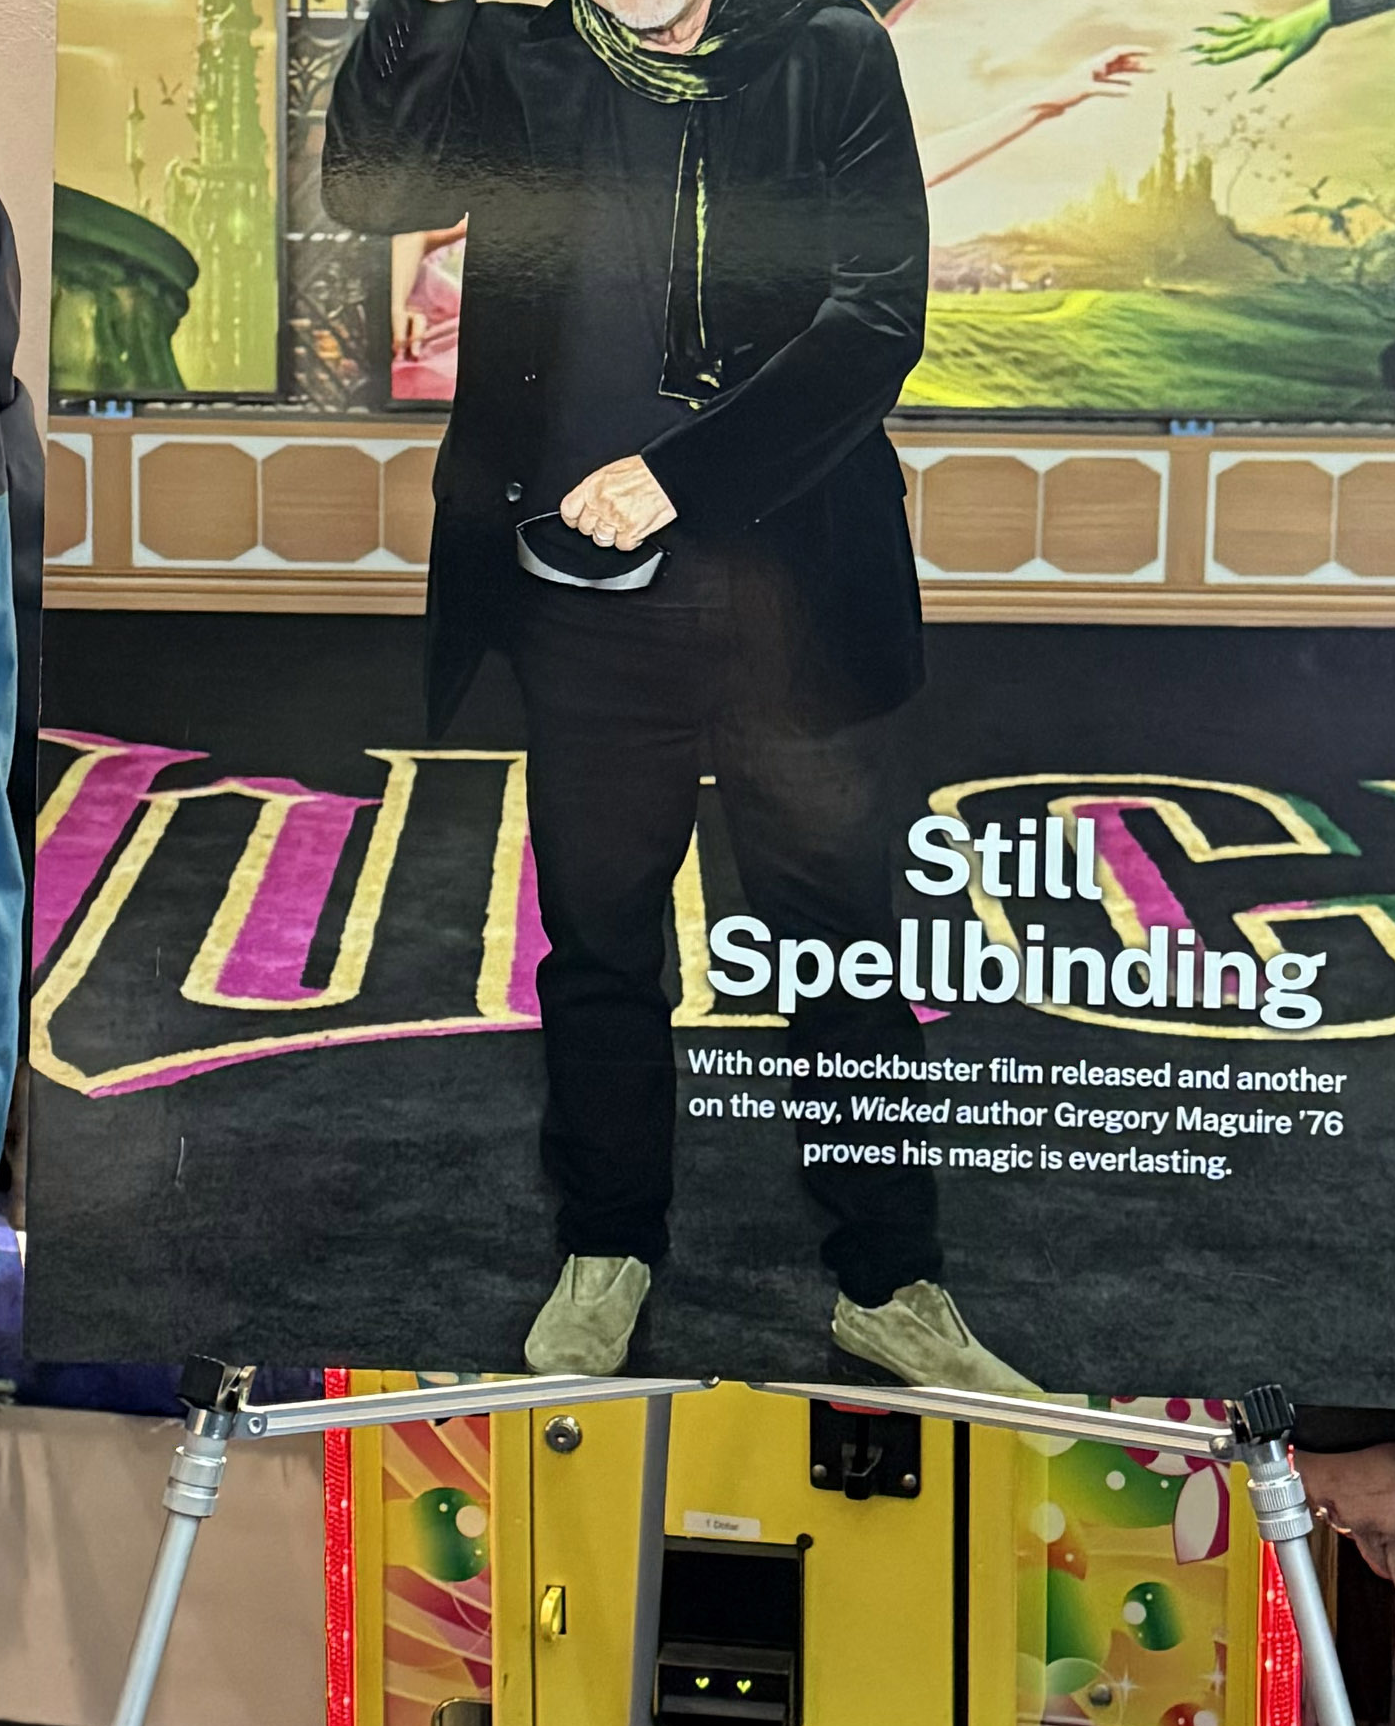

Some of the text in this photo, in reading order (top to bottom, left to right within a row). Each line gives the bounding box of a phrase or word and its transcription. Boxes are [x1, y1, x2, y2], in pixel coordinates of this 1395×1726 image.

[905, 815, 1104, 900] Still
[707, 915, 1327, 1030] Spellbinding
[688, 1049, 1347, 1093] With one blockbuster film released and another
[689, 1097, 723, 1117] on
[730, 1092, 775, 1119] the
[781, 1099, 842, 1125] way,
[851, 1095, 951, 1123] Wicked
[956, 1099, 1047, 1126] author
[1054, 1102, 1169, 1135] Gregory
[1176, 1106, 1292, 1138] Maguire
[804, 1139, 1232, 1180] proves his magic is everlasting.
